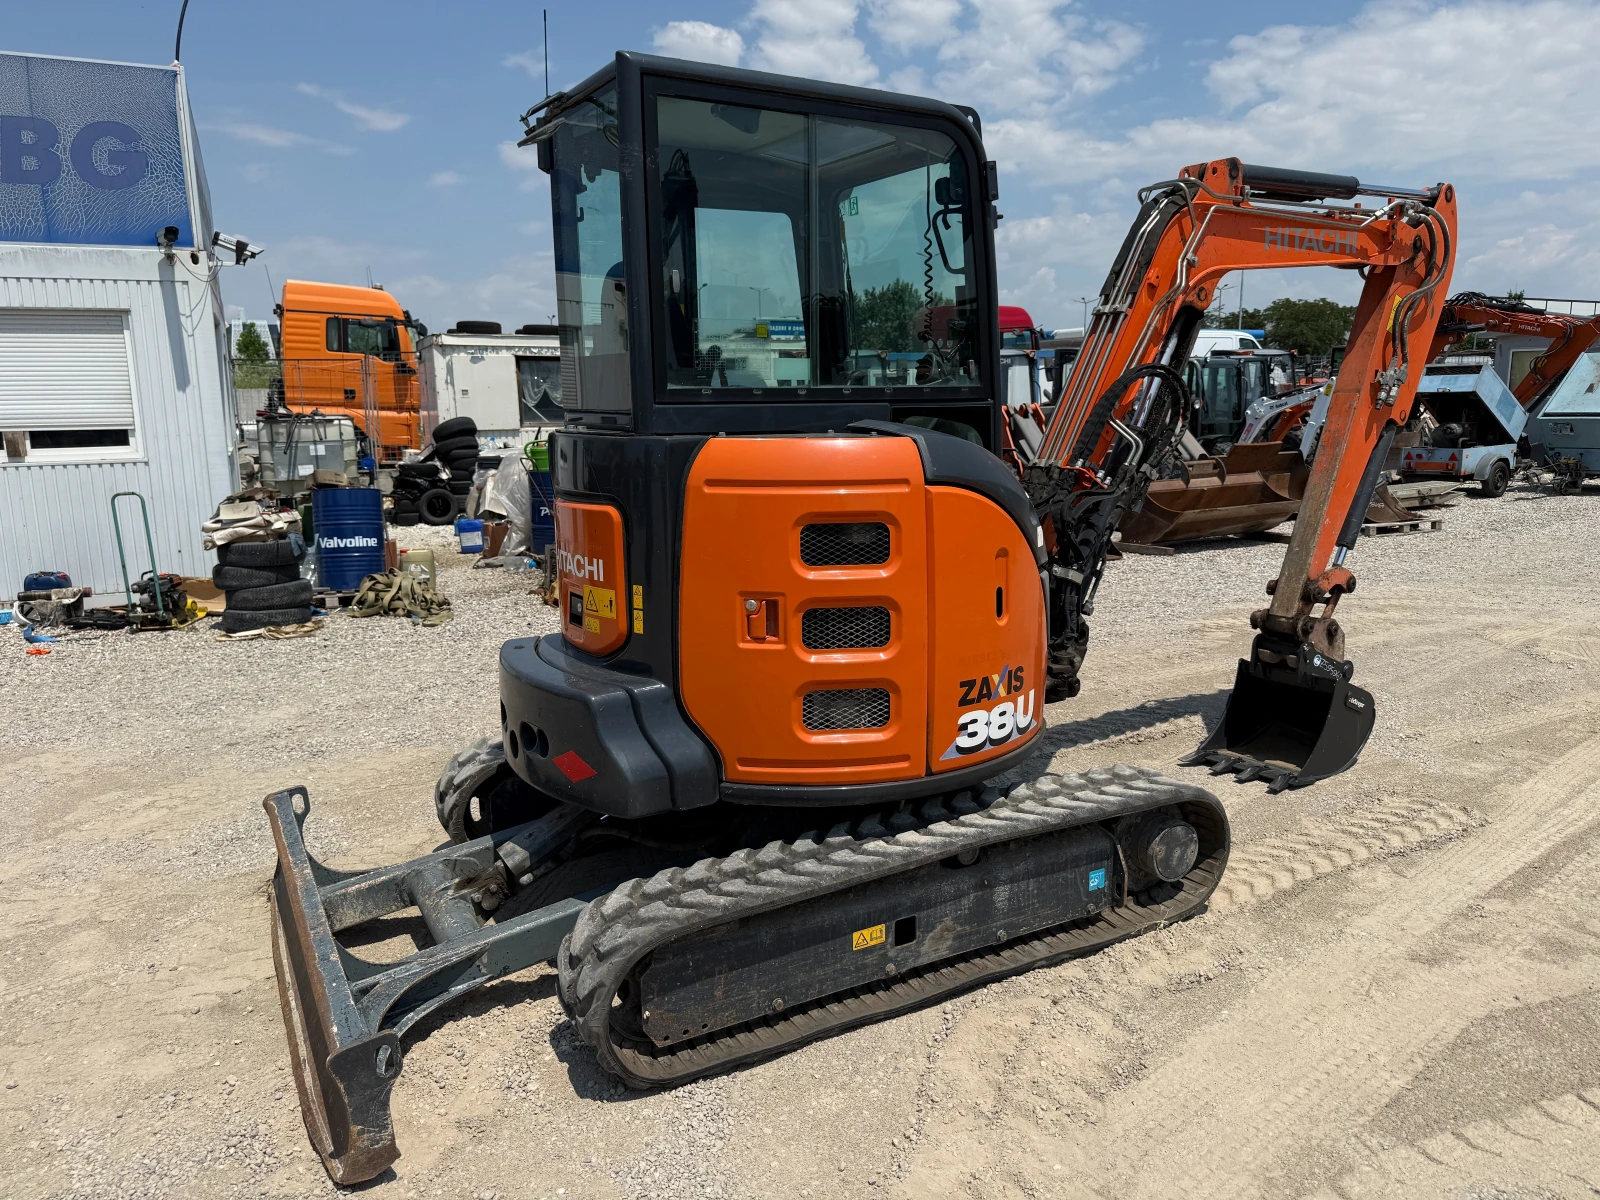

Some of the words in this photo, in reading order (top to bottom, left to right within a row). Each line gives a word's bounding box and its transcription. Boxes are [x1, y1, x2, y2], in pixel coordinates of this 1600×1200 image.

[1264, 225, 1358, 254] HITACHI
[1518, 323, 1541, 332] HITACHI
[319, 536, 378, 548] Valvoline
[958, 664, 1024, 707] ZAXIS
[955, 688, 1035, 754] 38U
